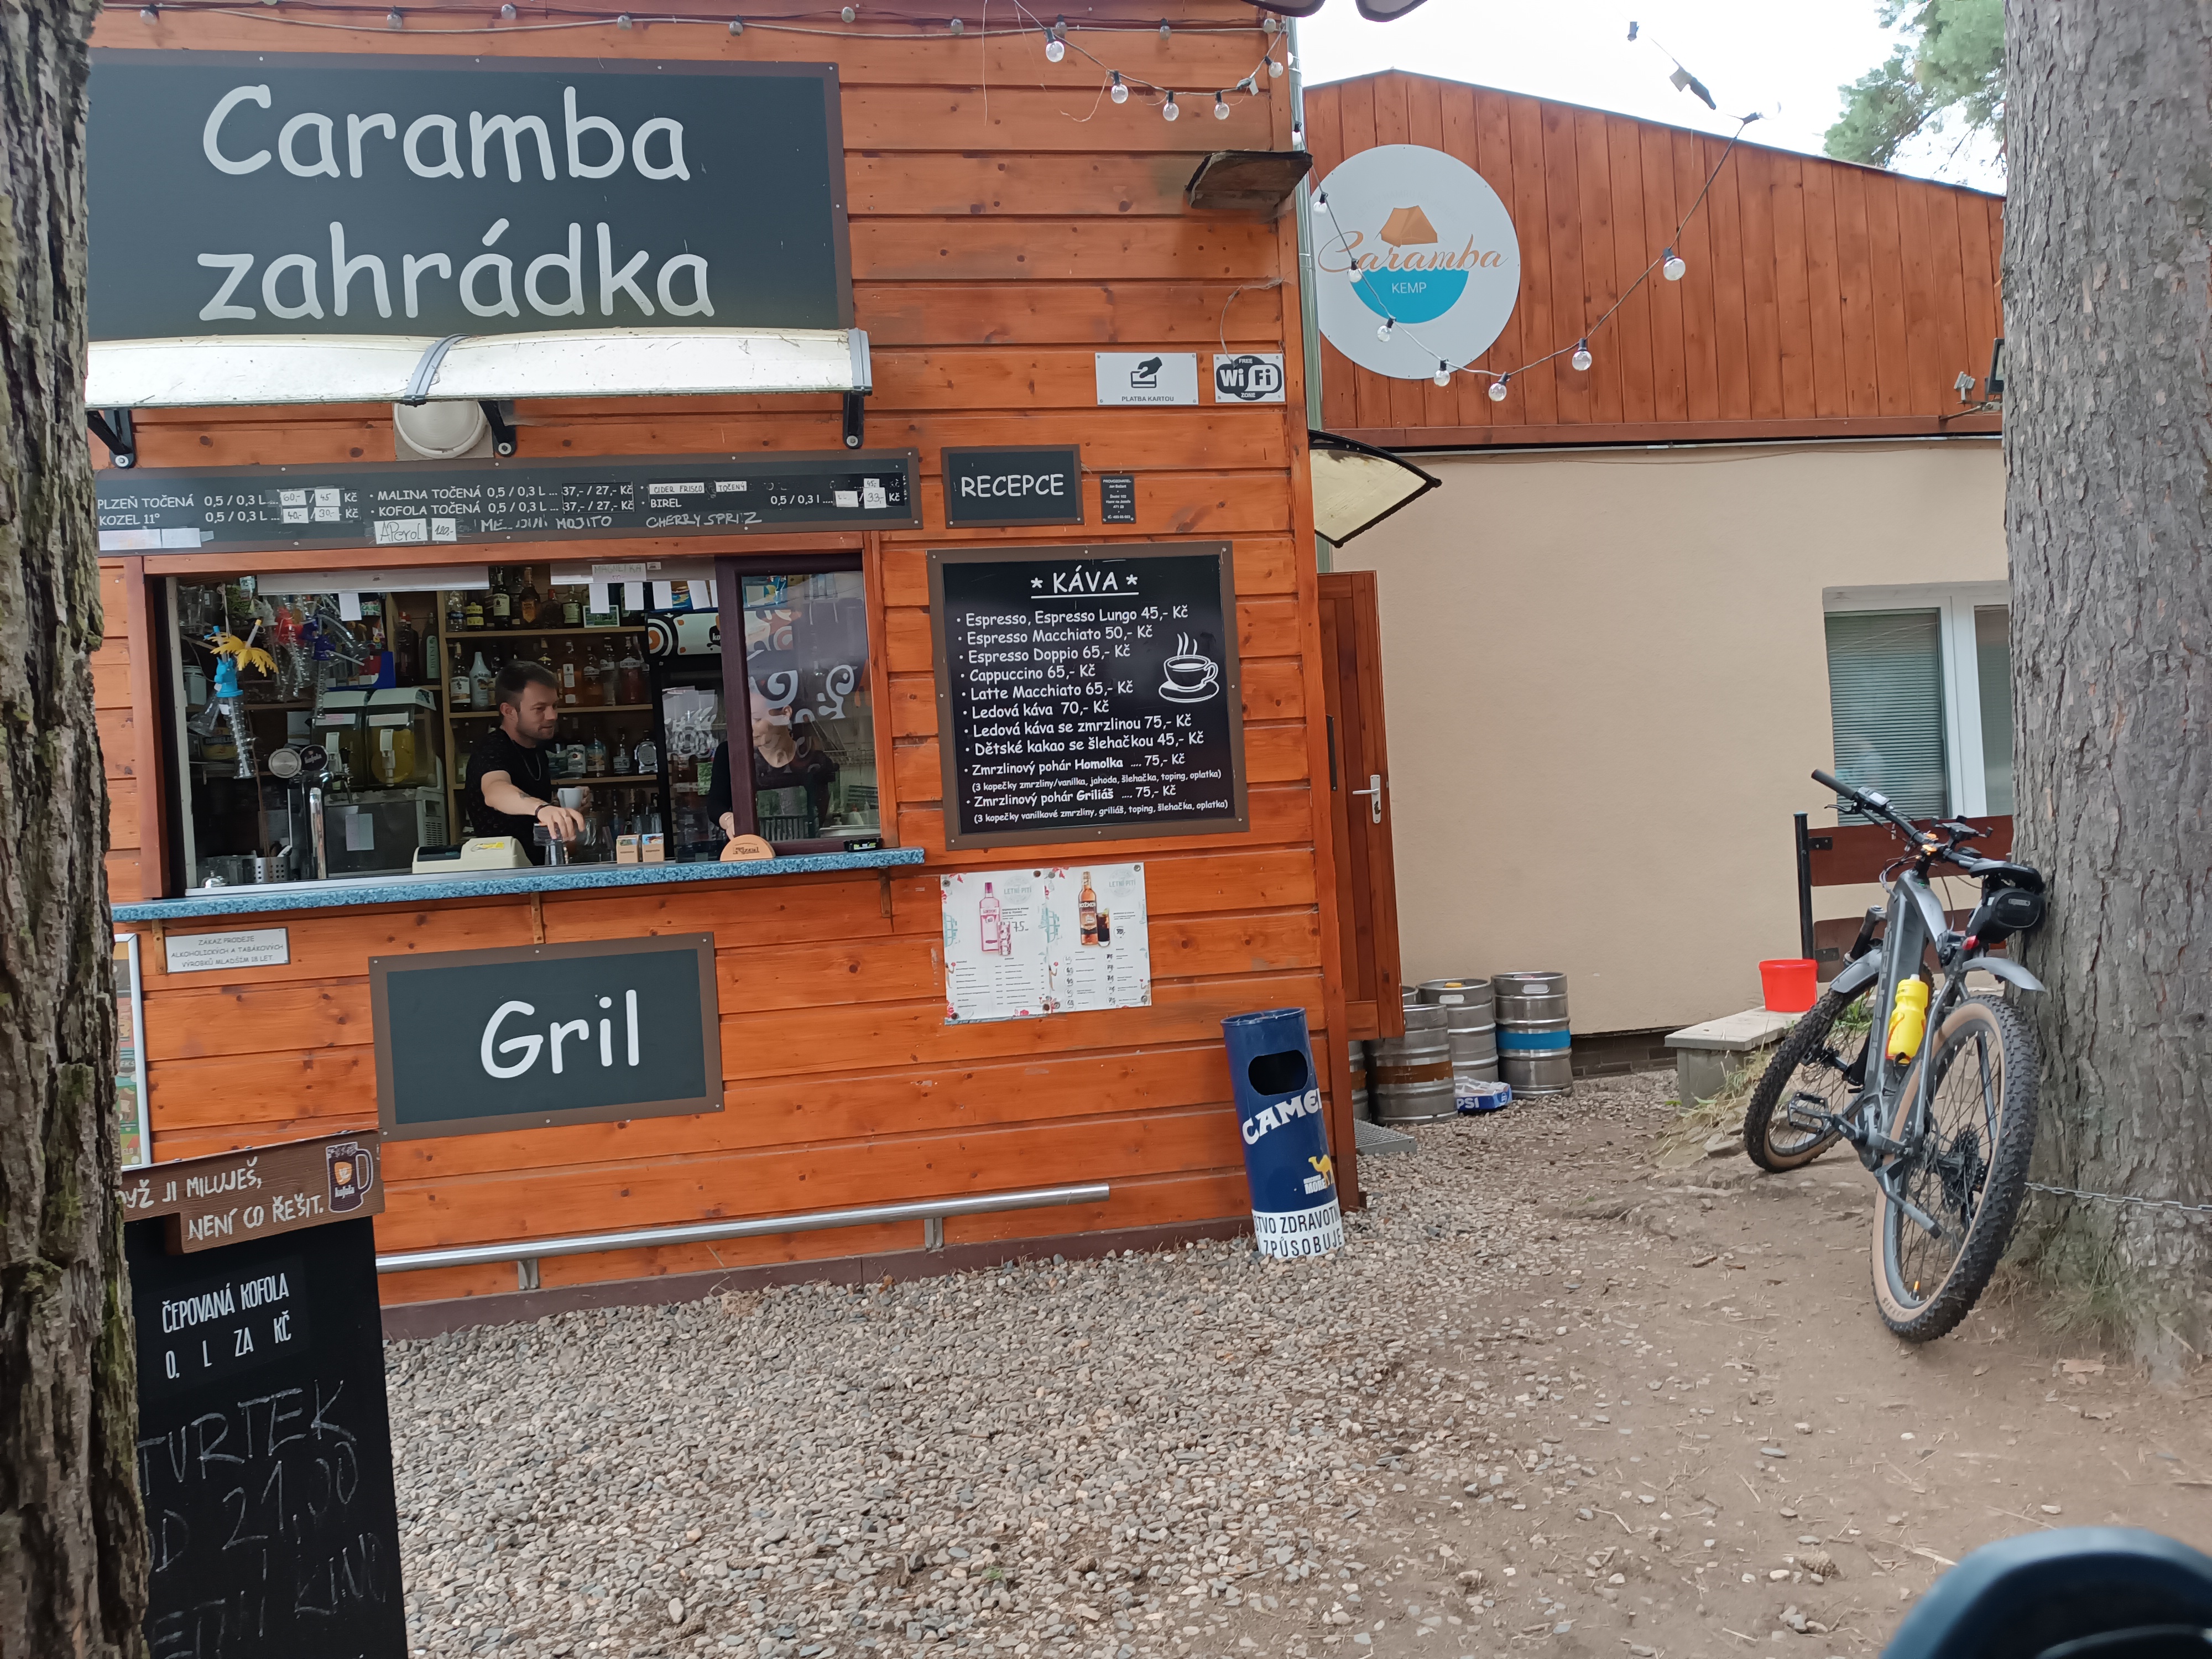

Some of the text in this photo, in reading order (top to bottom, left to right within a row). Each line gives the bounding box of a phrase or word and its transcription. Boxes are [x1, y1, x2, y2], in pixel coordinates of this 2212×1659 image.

[204, 85, 690, 182] Caramba
[1318, 231, 1509, 273] Caramba
[197, 218, 714, 321] zahrádka
[1392, 283, 1426, 293] KEMP
[378, 490, 427, 500] MALINA
[431, 485, 481, 498] TOČENÁ
[620, 483, 633, 495] Kč
[962, 474, 1063, 497] RECEPCE
[98, 496, 138, 509] PLZEŇ
[142, 494, 194, 508] TOČENÁ
[345, 493, 357, 502] Kč
[379, 506, 427, 516] KOFOLA
[431, 500, 480, 514] TOČENÁ
[622, 498, 634, 510] Kč
[651, 498, 681, 508] BIREL
[889, 493, 900, 501] Kč
[100, 515, 140, 525] KOZEL
[144, 513, 160, 524] 11°
[346, 508, 358, 518] Kč
[556, 516, 612, 529] MOJITO
[646, 514, 700, 528] CHERRY
[1053, 565, 1118, 593] KÁVA
[966, 604, 1188, 629] Espresso, Espresso Lungo 45,- Kč
[968, 625, 1152, 648] Espresso Macchiato 50,- Kč
[969, 644, 1130, 666] Espresso Doppio 65,- Kč
[970, 664, 1095, 685] Cappuccino 65,- Kč
[971, 680, 1133, 700] Latte Macchiato 65,- Kč
[973, 700, 1109, 719] Ledová káva 70,- Kč
[974, 714, 1191, 737] Ledová káva se zmrzlinou 75,- Kč
[975, 731, 1203, 755] Dětské kakao se šlehačkou 45,- Kč
[972, 753, 1186, 775] Zmrzlinový pohár Homolka 75,- Kč
[972, 783, 980, 792] (3
[984, 781, 1017, 792] kopečky
[1090, 776, 1119, 786] jahoda,
[1121, 774, 1159, 782] šlehačka,
[1161, 772, 1188, 782] toping,
[1190, 769, 1221, 780] oplatka)
[974, 785, 1176, 807] Zmrzlinový pohár Griliáš 75,- Kč
[974, 815, 983, 823] (3
[985, 812, 1019, 823] kopečky
[1128, 805, 1155, 815] toping,
[1157, 802, 1194, 811] šlehačka,
[1197, 800, 1228, 811] oplatka)
[171, 948, 228, 958] ALKOHOLICKÝCH
[238, 944, 284, 953] TABÁKOVÝCH
[182, 958, 213, 967] VÝROBKŮ
[216, 956, 249, 964] MLADŠÍM
[481, 990, 639, 1078] Gril
[1457, 1097, 1479, 1109] PSI
[163, 1181, 176, 1202] JI
[187, 1156, 262, 1197] MILUJEŠ,
[188, 1193, 324, 1240] NENÍ CO ŘEŠIT.
[163, 1273, 289, 1333] ČEPOVANÁ KOFOLA
[203, 1340, 212, 1367] L
[234, 1327, 253, 1357] ZA
[274, 1310, 291, 1343] KČ
